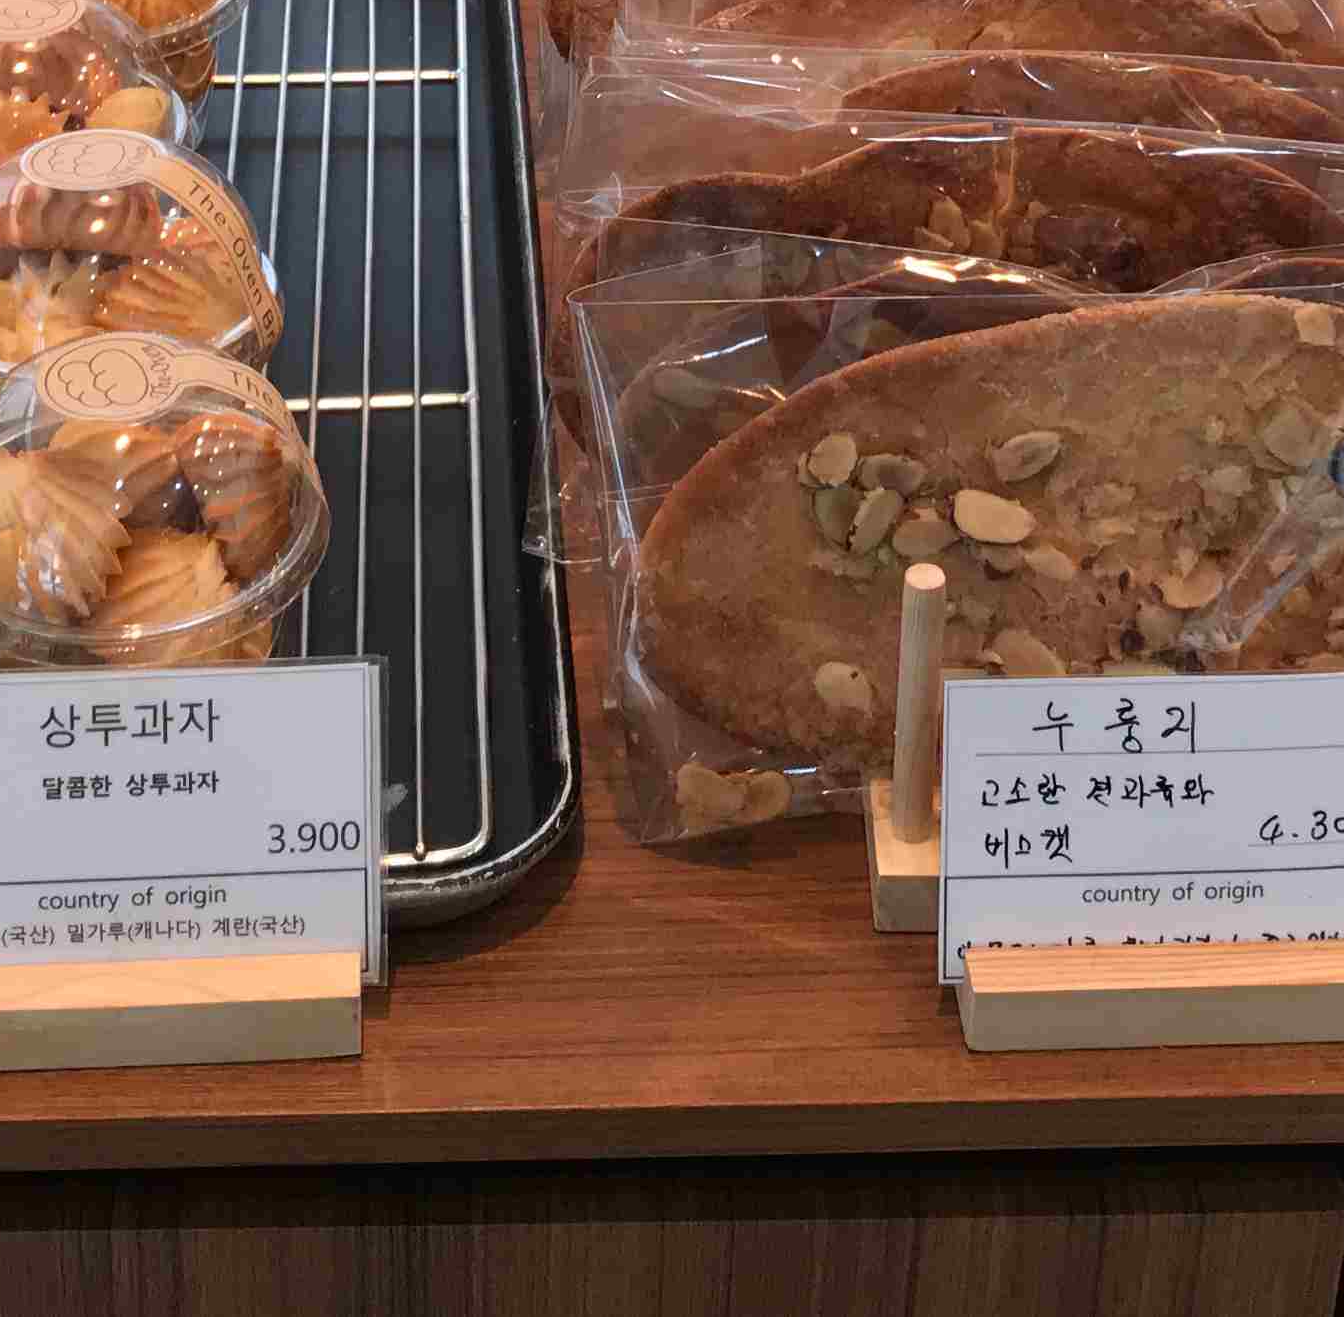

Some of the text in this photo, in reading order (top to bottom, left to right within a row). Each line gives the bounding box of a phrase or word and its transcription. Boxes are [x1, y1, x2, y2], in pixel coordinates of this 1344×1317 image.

[39, 697, 221, 749] 상투과자
[42, 769, 220, 801] 달콤한 상투과자
[267, 820, 362, 855] 3.900
[37, 884, 228, 913] country of origin
[1082, 880, 1265, 905] country of origin
[66, 919, 202, 943] 밀가루(캐나다)
[212, 913, 306, 939] 계란(국산)
